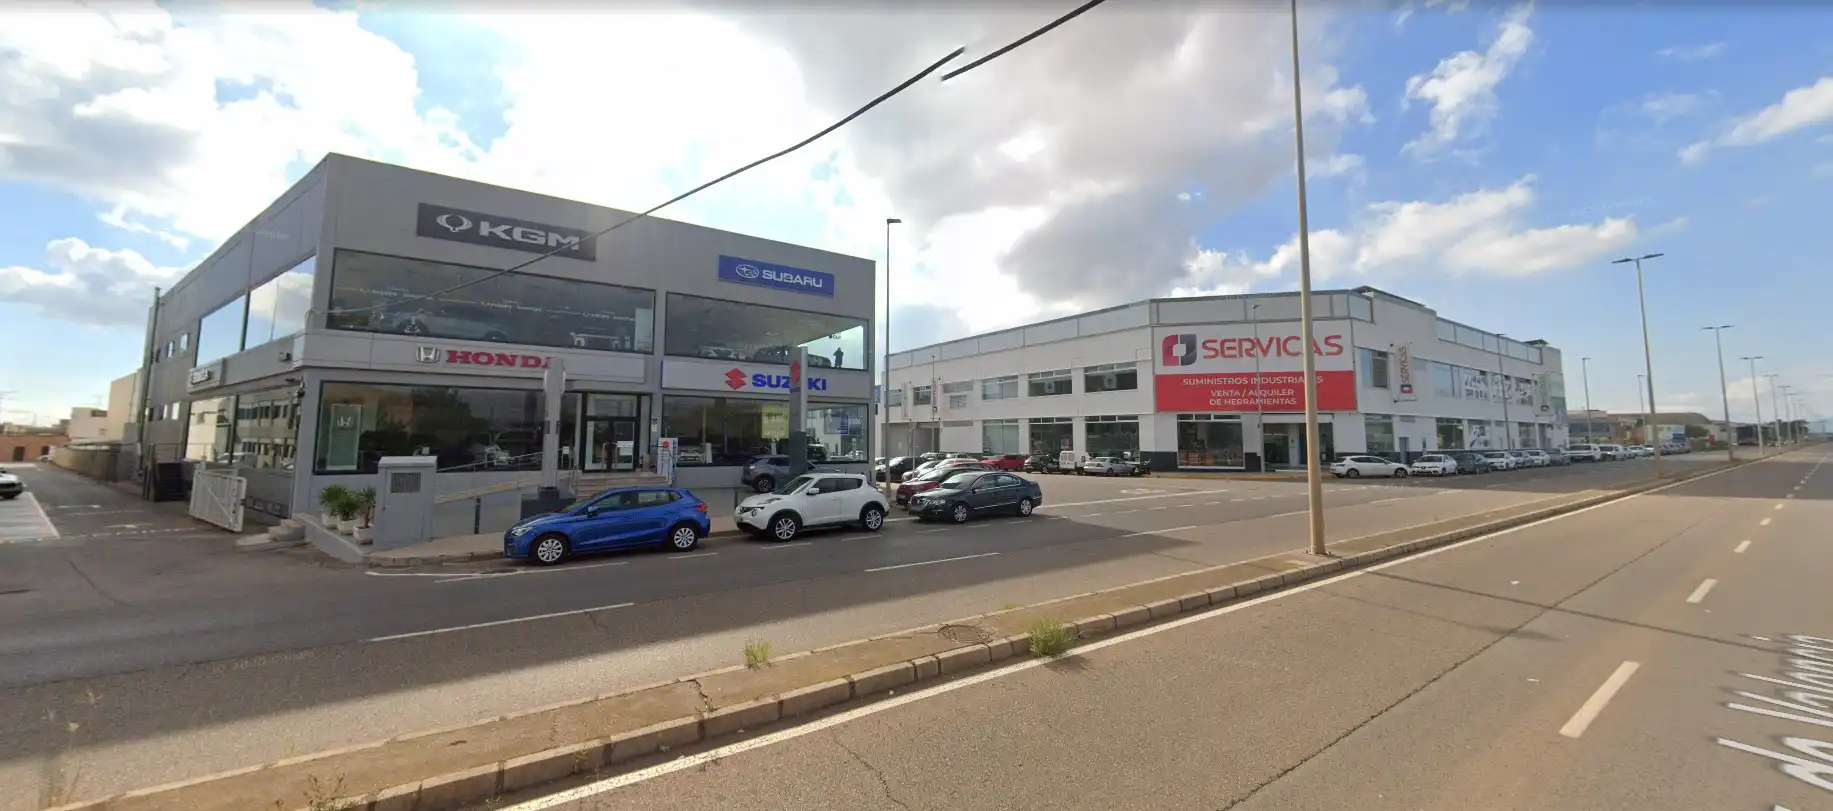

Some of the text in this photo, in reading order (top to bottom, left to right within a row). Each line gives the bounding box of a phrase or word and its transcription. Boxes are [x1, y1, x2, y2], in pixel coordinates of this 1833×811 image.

[480, 220, 580, 251] KGM
[762, 269, 823, 288] SUBARU
[752, 373, 827, 391] SUZKI
[1183, 376, 1324, 386] SUMINISTROS INDUSTRIAS
[1210, 389, 1241, 397] VENTA
[1248, 388, 1294, 398] ALQUILER
[1209, 398, 1297, 406] DE HERRAMIENTAS
